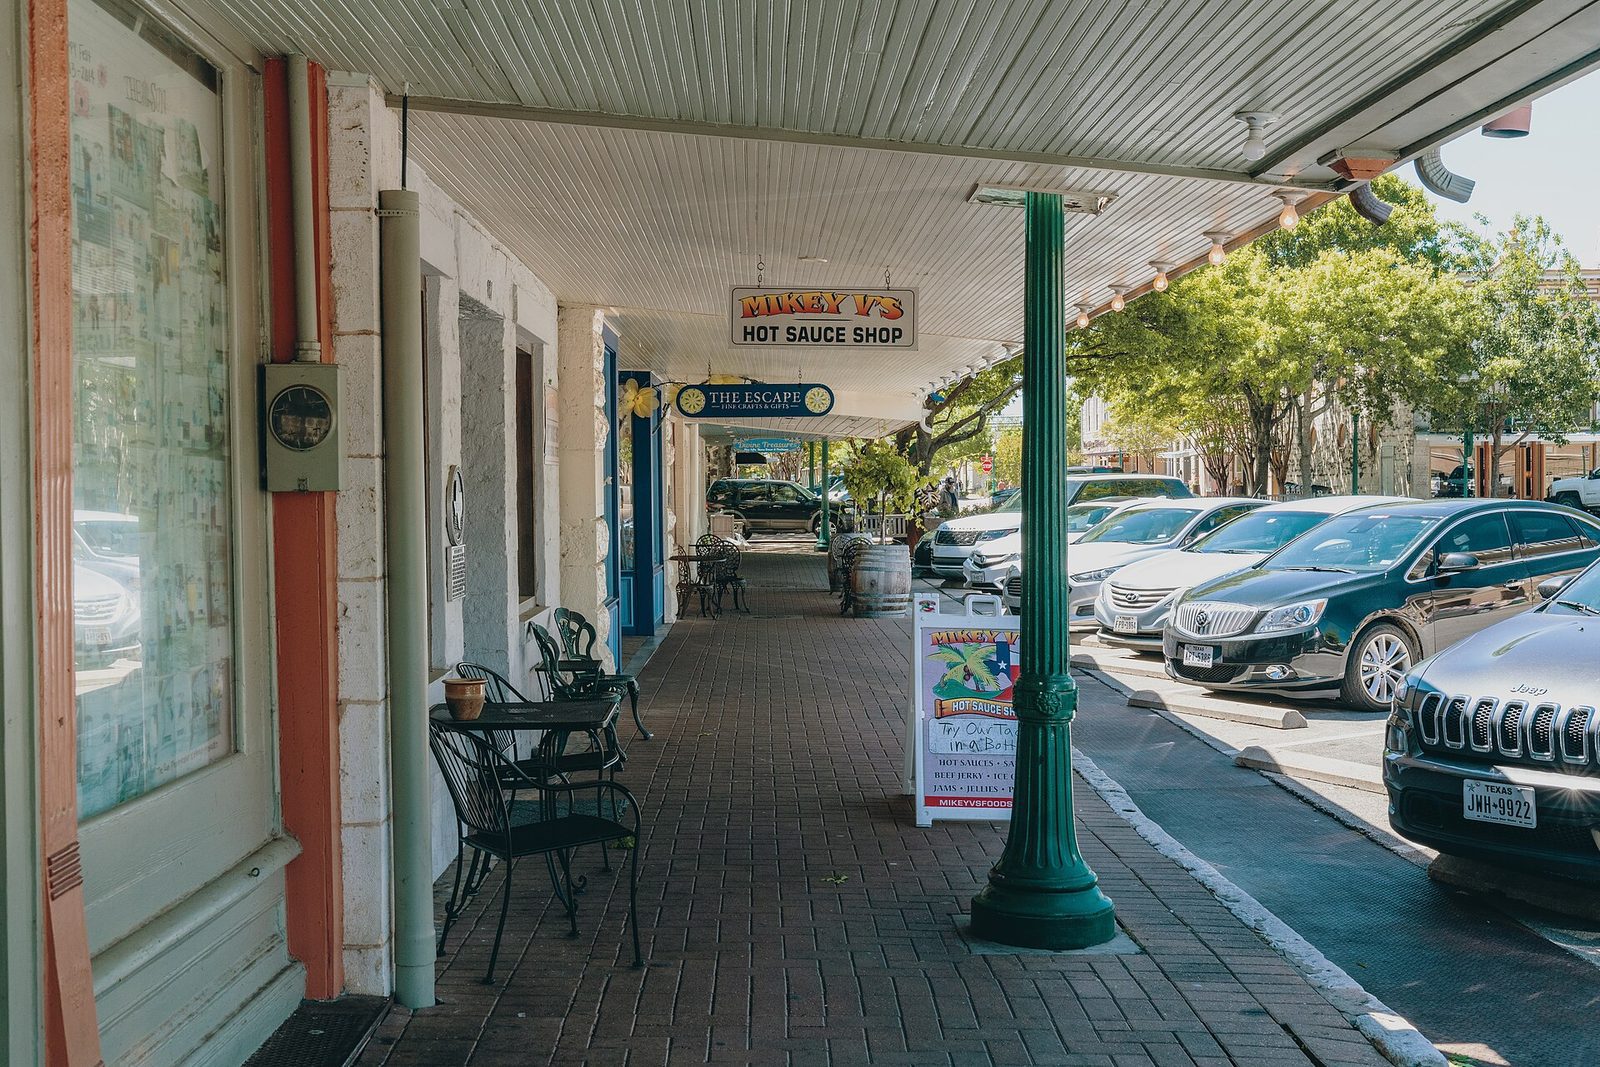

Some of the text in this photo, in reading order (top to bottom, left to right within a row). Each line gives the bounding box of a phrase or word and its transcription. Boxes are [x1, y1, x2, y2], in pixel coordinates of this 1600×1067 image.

[738, 291, 904, 320] MIKEY V'S
[743, 325, 903, 344] HOT SAUCE SHOP
[709, 391, 802, 403] THE ESCAPE
[762, 441, 797, 449] Treasures
[929, 630, 1020, 646] MIKEY V
[1510, 683, 1548, 697] Jeep
[952, 700, 1016, 716] HOT SAUCE SH
[938, 722, 1019, 738] Try Our Tac
[985, 737, 1017, 751] Bott
[939, 759, 959, 767] HOT
[960, 759, 994, 767] SAUCES
[957, 772, 984, 780] JERKY
[933, 784, 998, 793] JAMS JELLIES
[1484, 784, 1513, 795] TEXAS
[939, 799, 1013, 807] MIKEYVSFOODS
